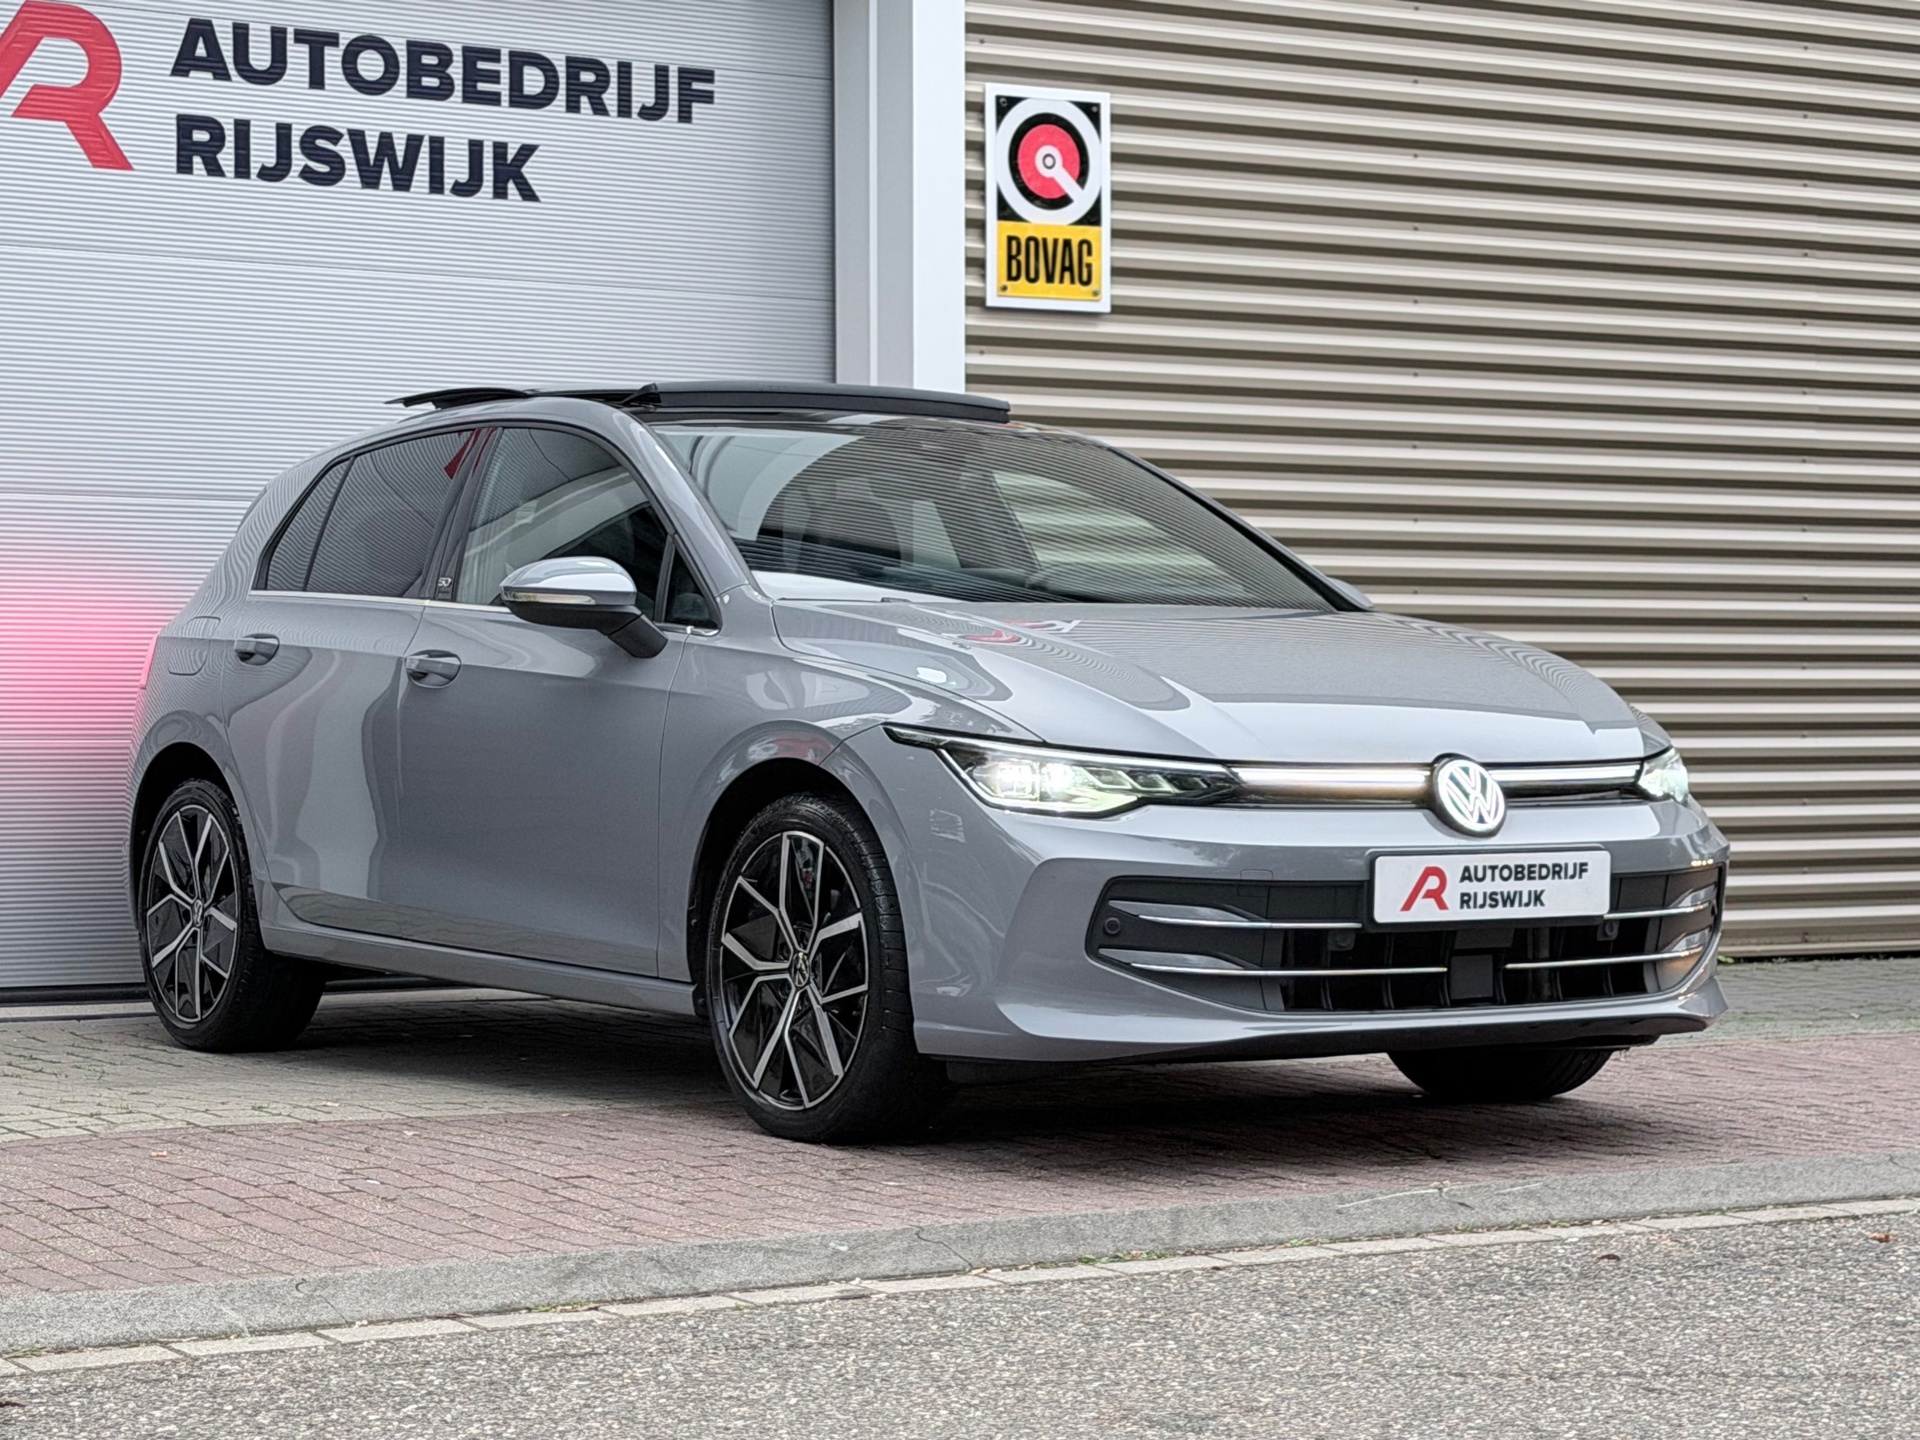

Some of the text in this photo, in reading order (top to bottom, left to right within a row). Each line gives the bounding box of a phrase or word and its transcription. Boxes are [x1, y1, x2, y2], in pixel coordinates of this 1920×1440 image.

[170, 17, 716, 124] AUTOBEDRIJF
[175, 114, 541, 202] RIJSWIJK
[1006, 235, 1094, 287] BOVAG
[1459, 861, 1589, 884] AUTOBEDRIJF
[1459, 889, 1546, 910] RIJSWIJK
